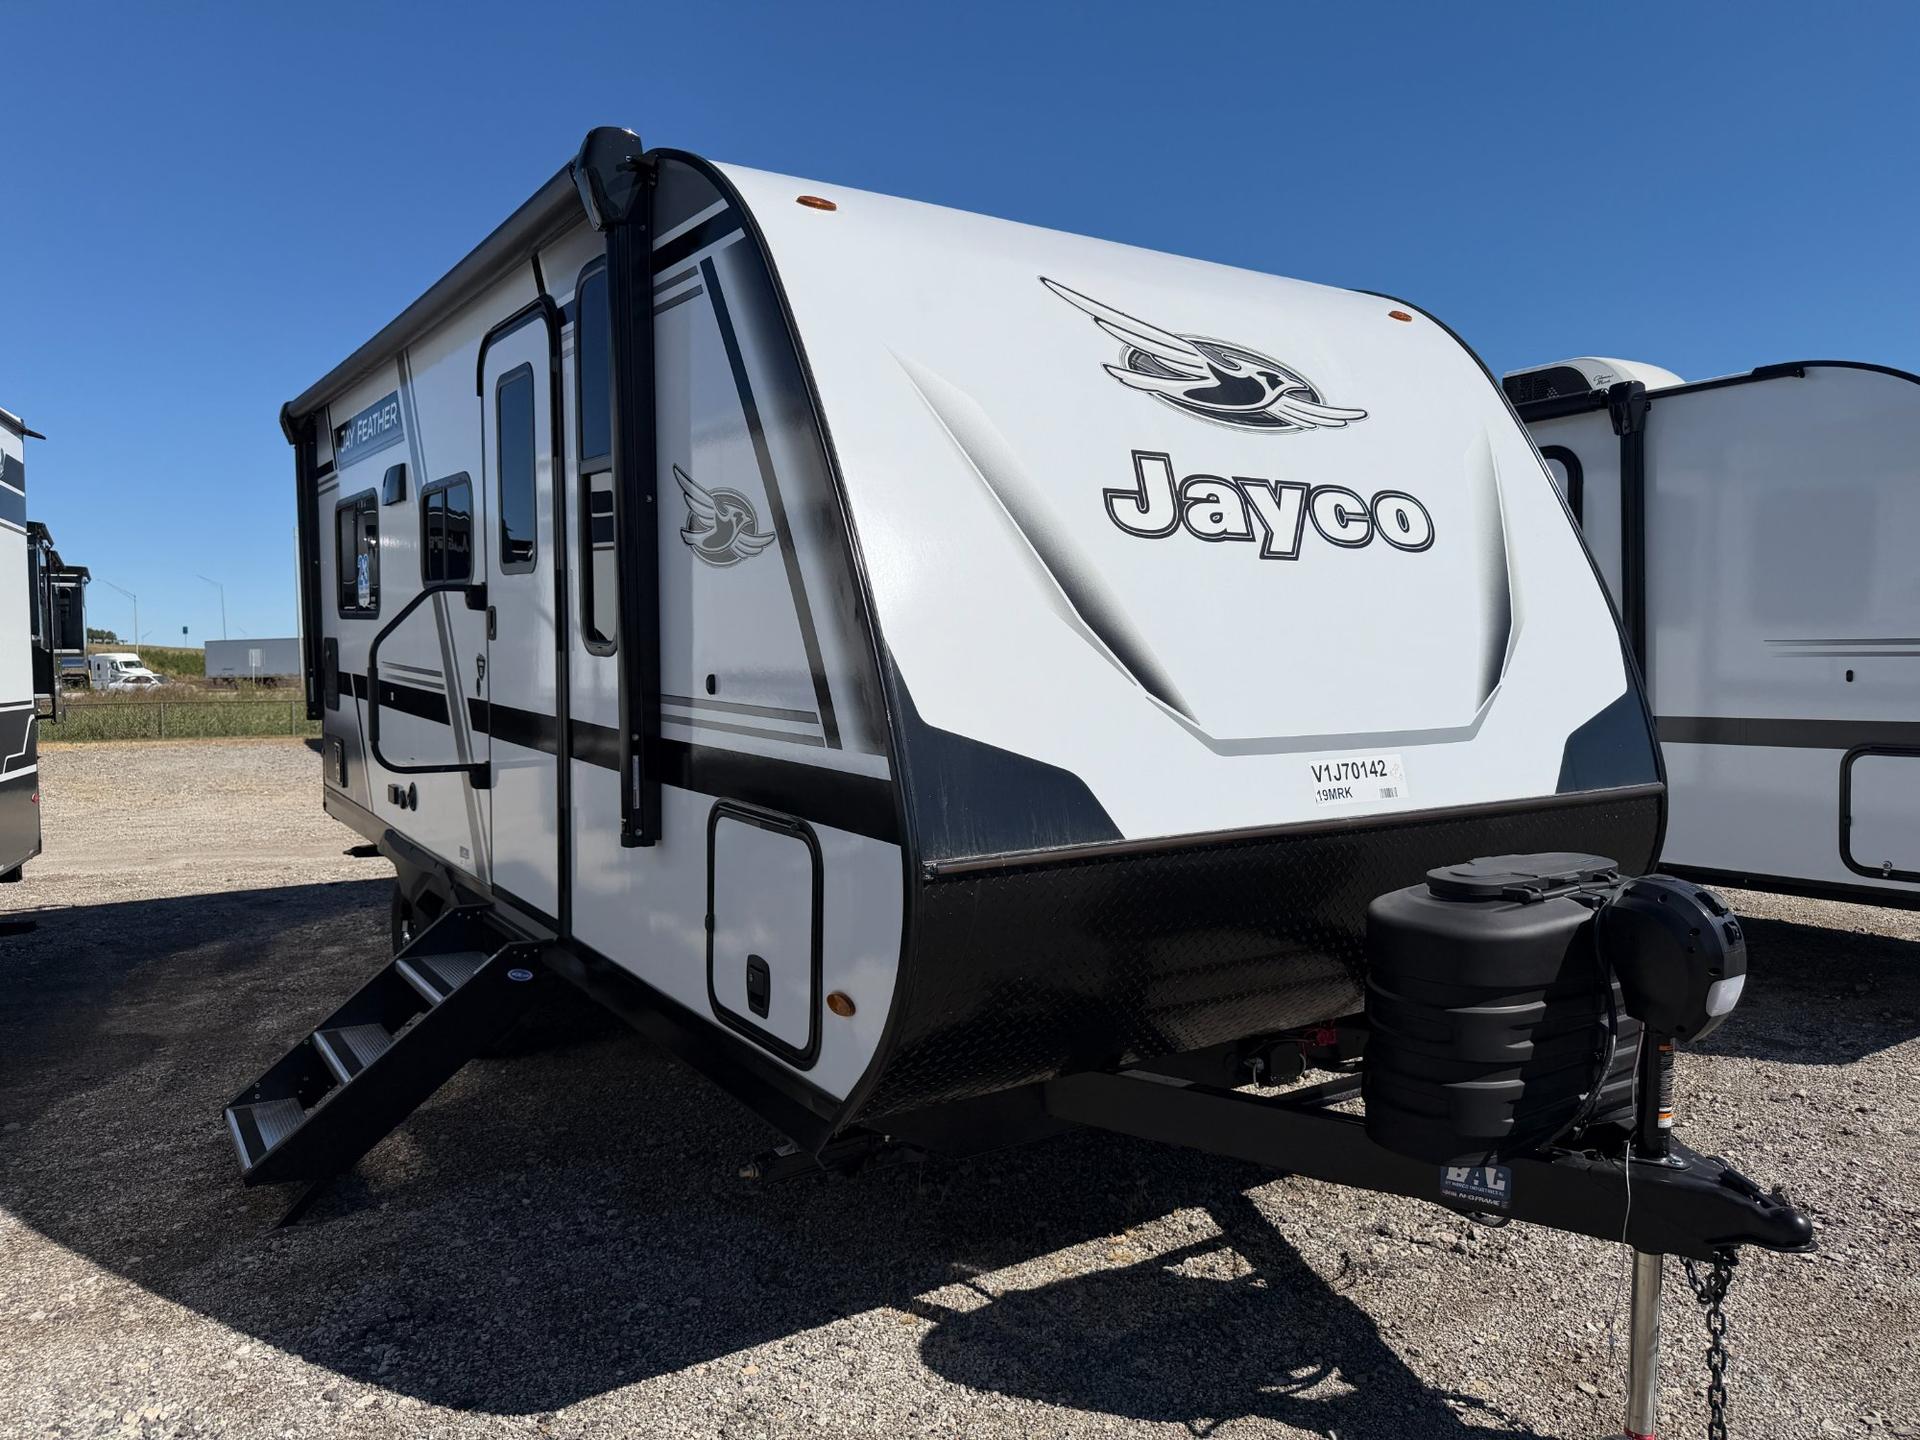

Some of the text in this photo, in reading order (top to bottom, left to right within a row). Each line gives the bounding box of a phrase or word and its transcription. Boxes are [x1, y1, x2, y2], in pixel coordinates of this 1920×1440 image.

[340, 402, 397, 453] JAY FEATHER
[1102, 449, 1436, 561] Jayco
[1311, 760, 1388, 783] V1J70142
[1316, 786, 1353, 801] 19MRK
